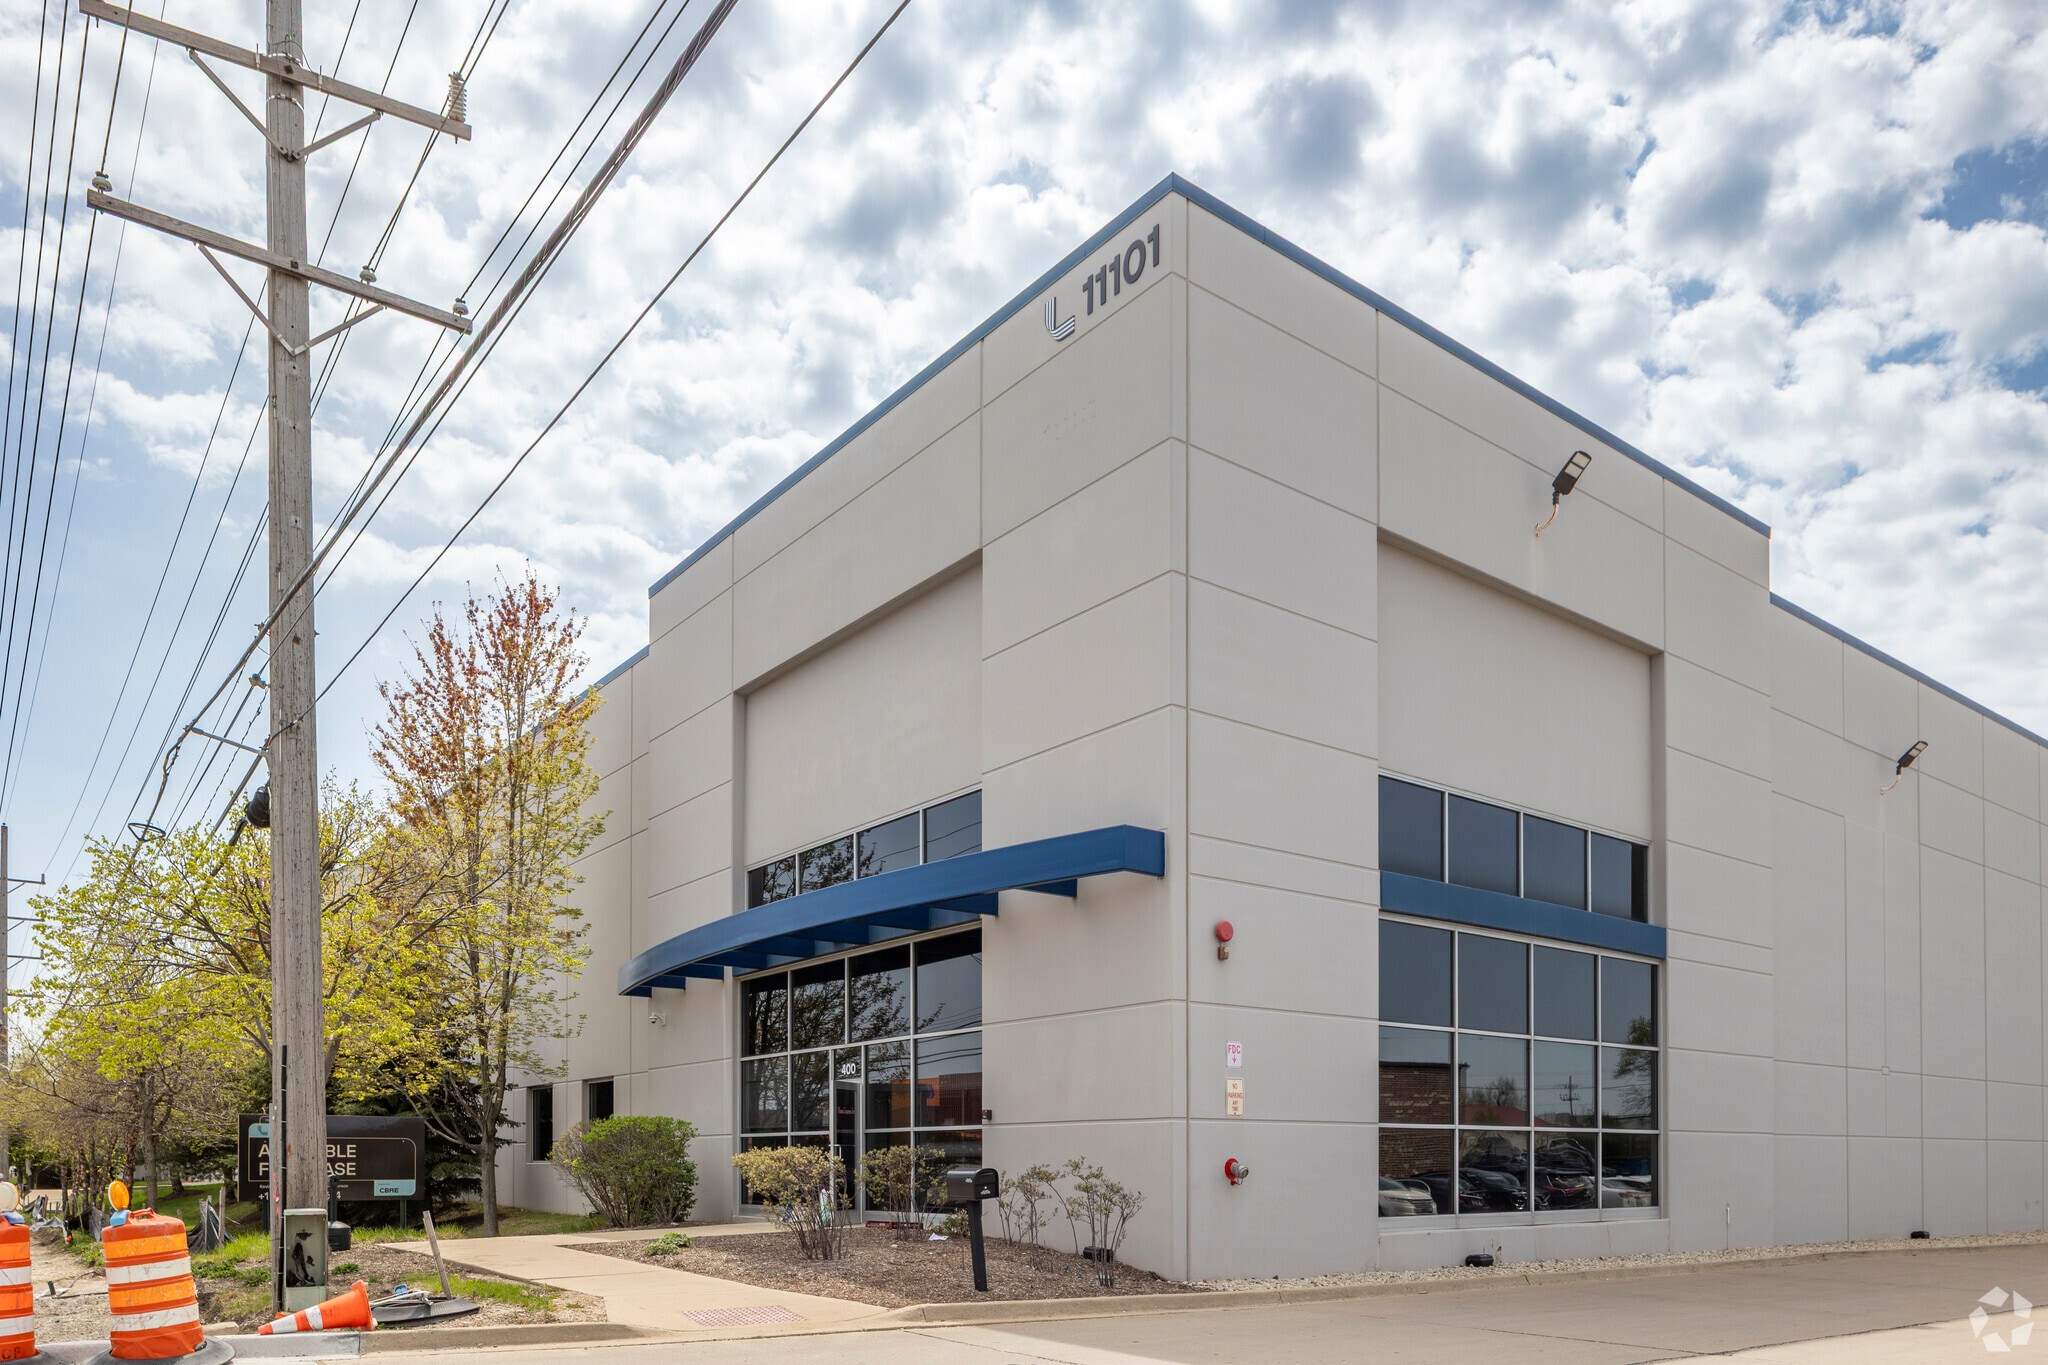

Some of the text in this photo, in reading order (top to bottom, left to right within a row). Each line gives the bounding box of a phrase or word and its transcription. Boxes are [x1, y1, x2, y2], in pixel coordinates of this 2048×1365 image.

[1082, 223, 1160, 316] 11101
[1227, 1044, 1241, 1054] FDC
[841, 1063, 856, 1075] 400
[326, 1162, 356, 1176] ASE
